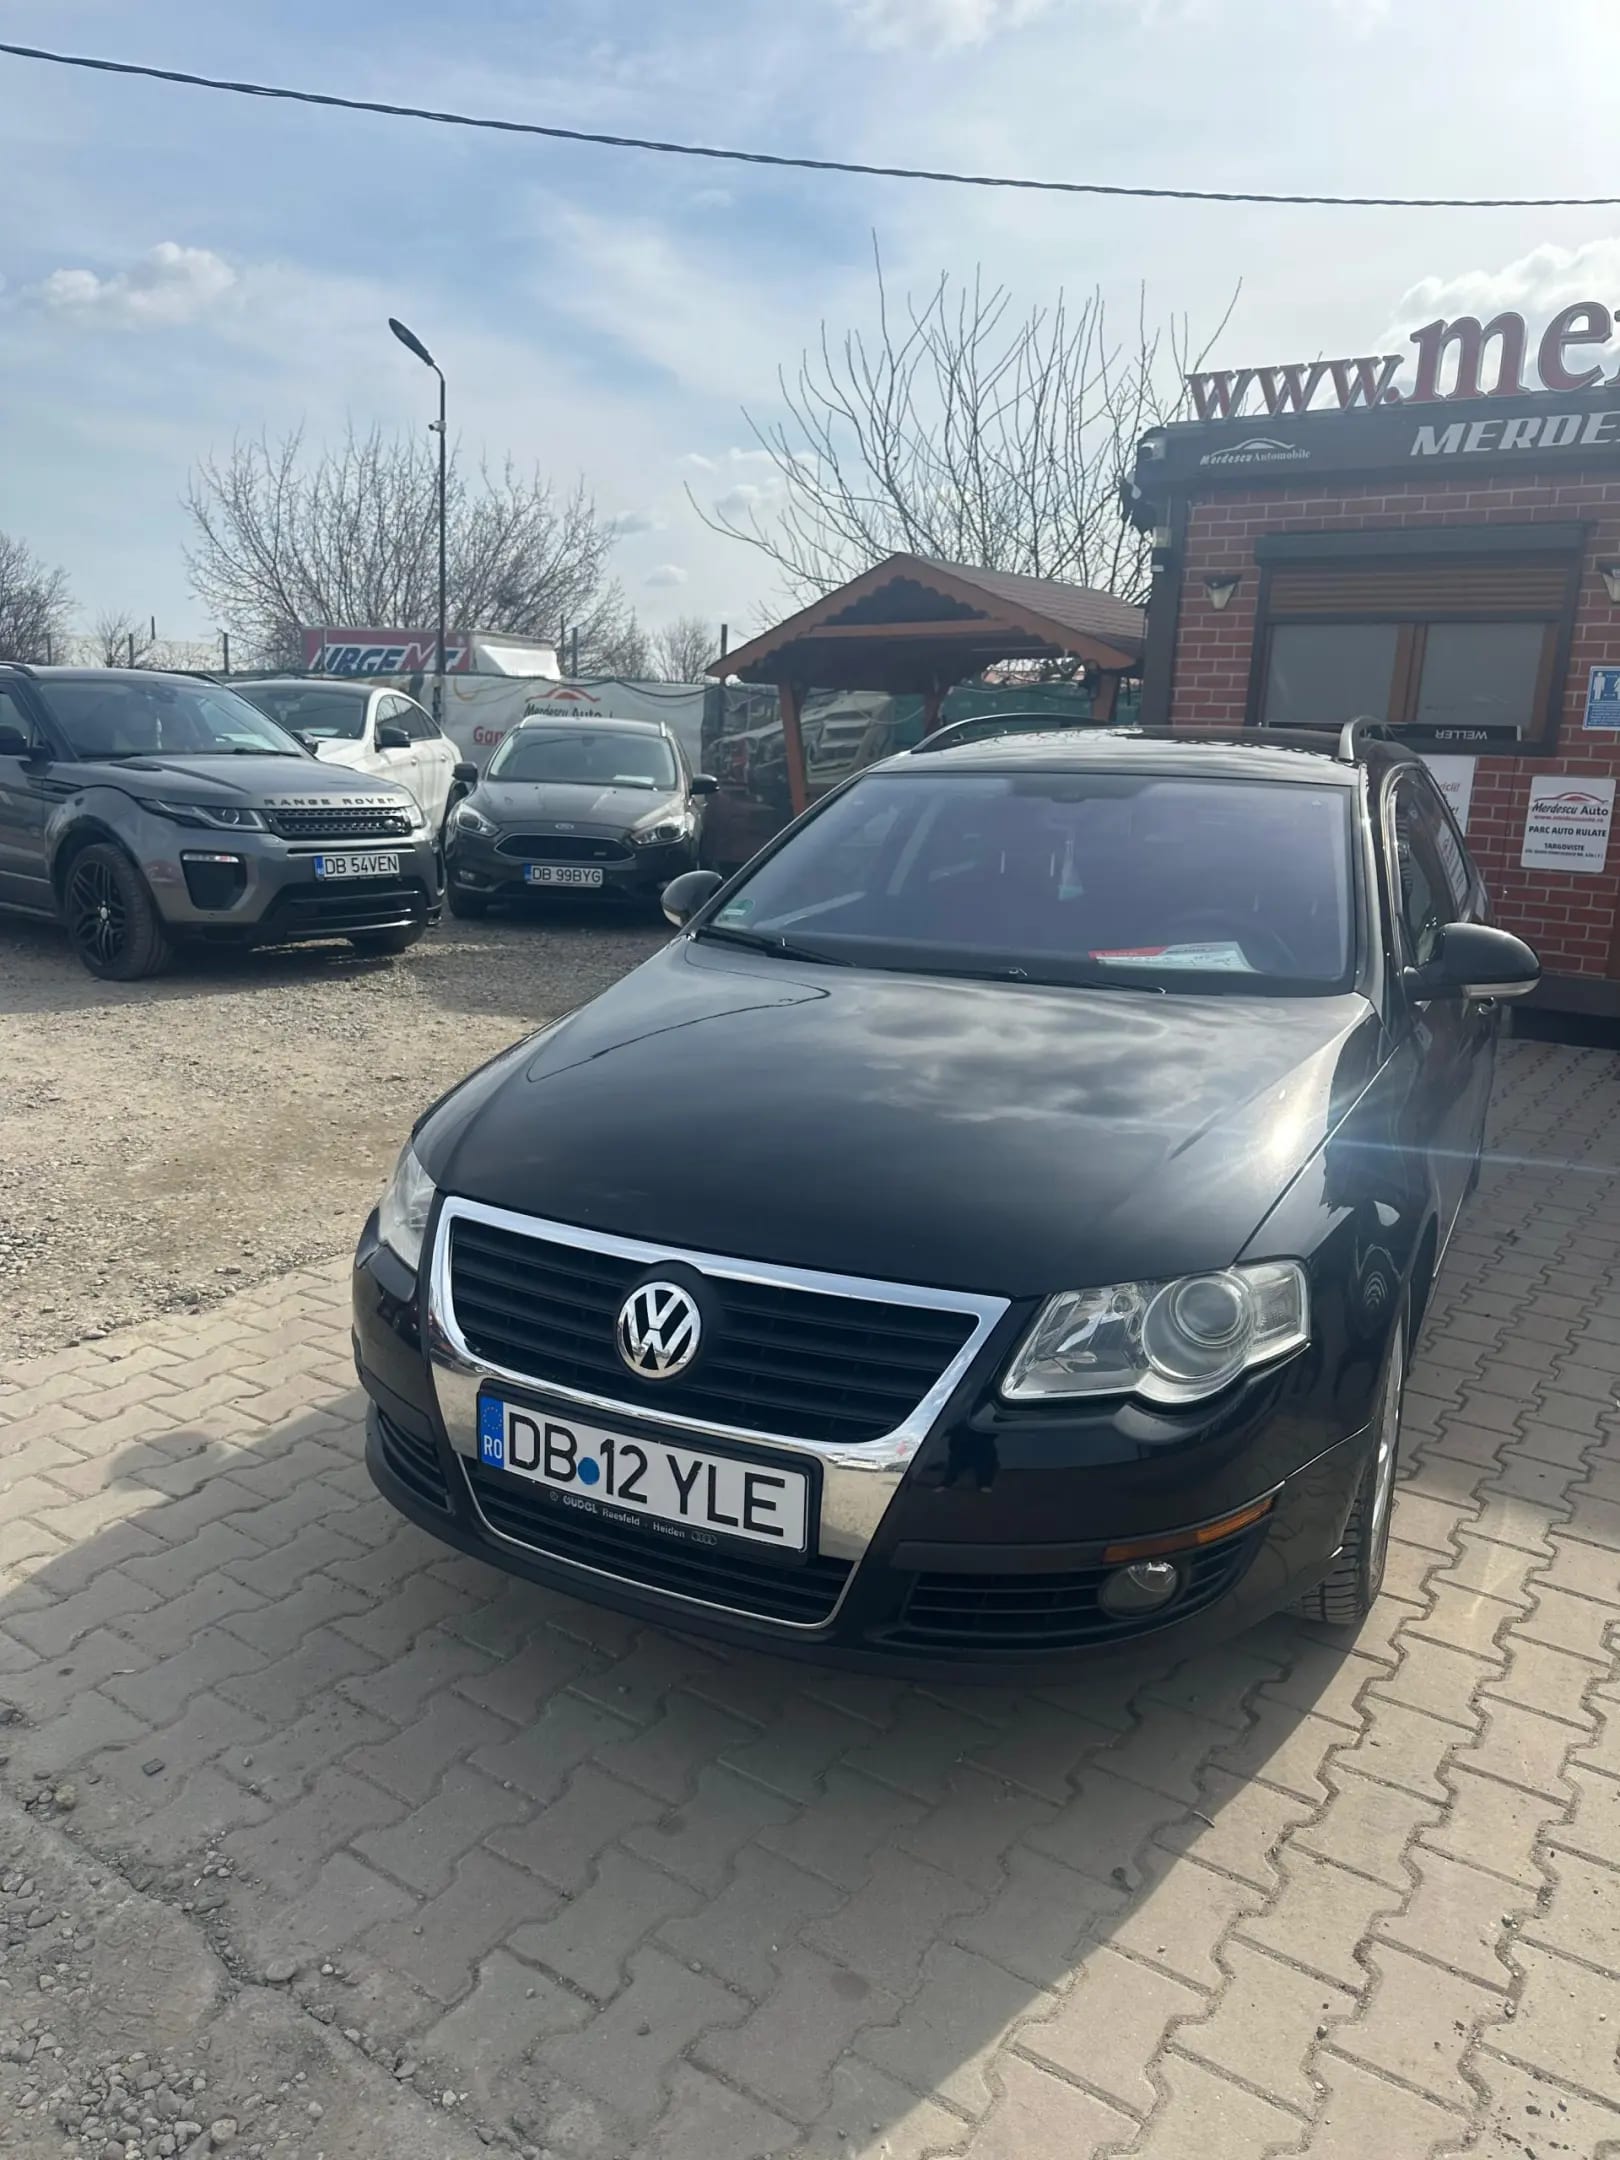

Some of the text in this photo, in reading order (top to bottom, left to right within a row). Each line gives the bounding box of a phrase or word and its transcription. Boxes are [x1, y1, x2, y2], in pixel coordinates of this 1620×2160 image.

[1184, 301, 1620, 420] www.me
[1410, 411, 1620, 456] MERDE
[1253, 449, 1311, 461] Automobile
[1435, 729, 1488, 740] WELLER
[264, 797, 395, 806] RANGE ROVER
[1532, 802, 1608, 816] Merdescu Auto
[1529, 825, 1607, 838] PARC AUTO RULATE
[325, 858, 346, 875] DB
[352, 856, 398, 873] 54VEN
[532, 867, 601, 883] DB 99BYG
[483, 1434, 503, 1460] RO
[509, 1412, 786, 1537] DB 12 YLE
[653, 1521, 686, 1539] Heiden
